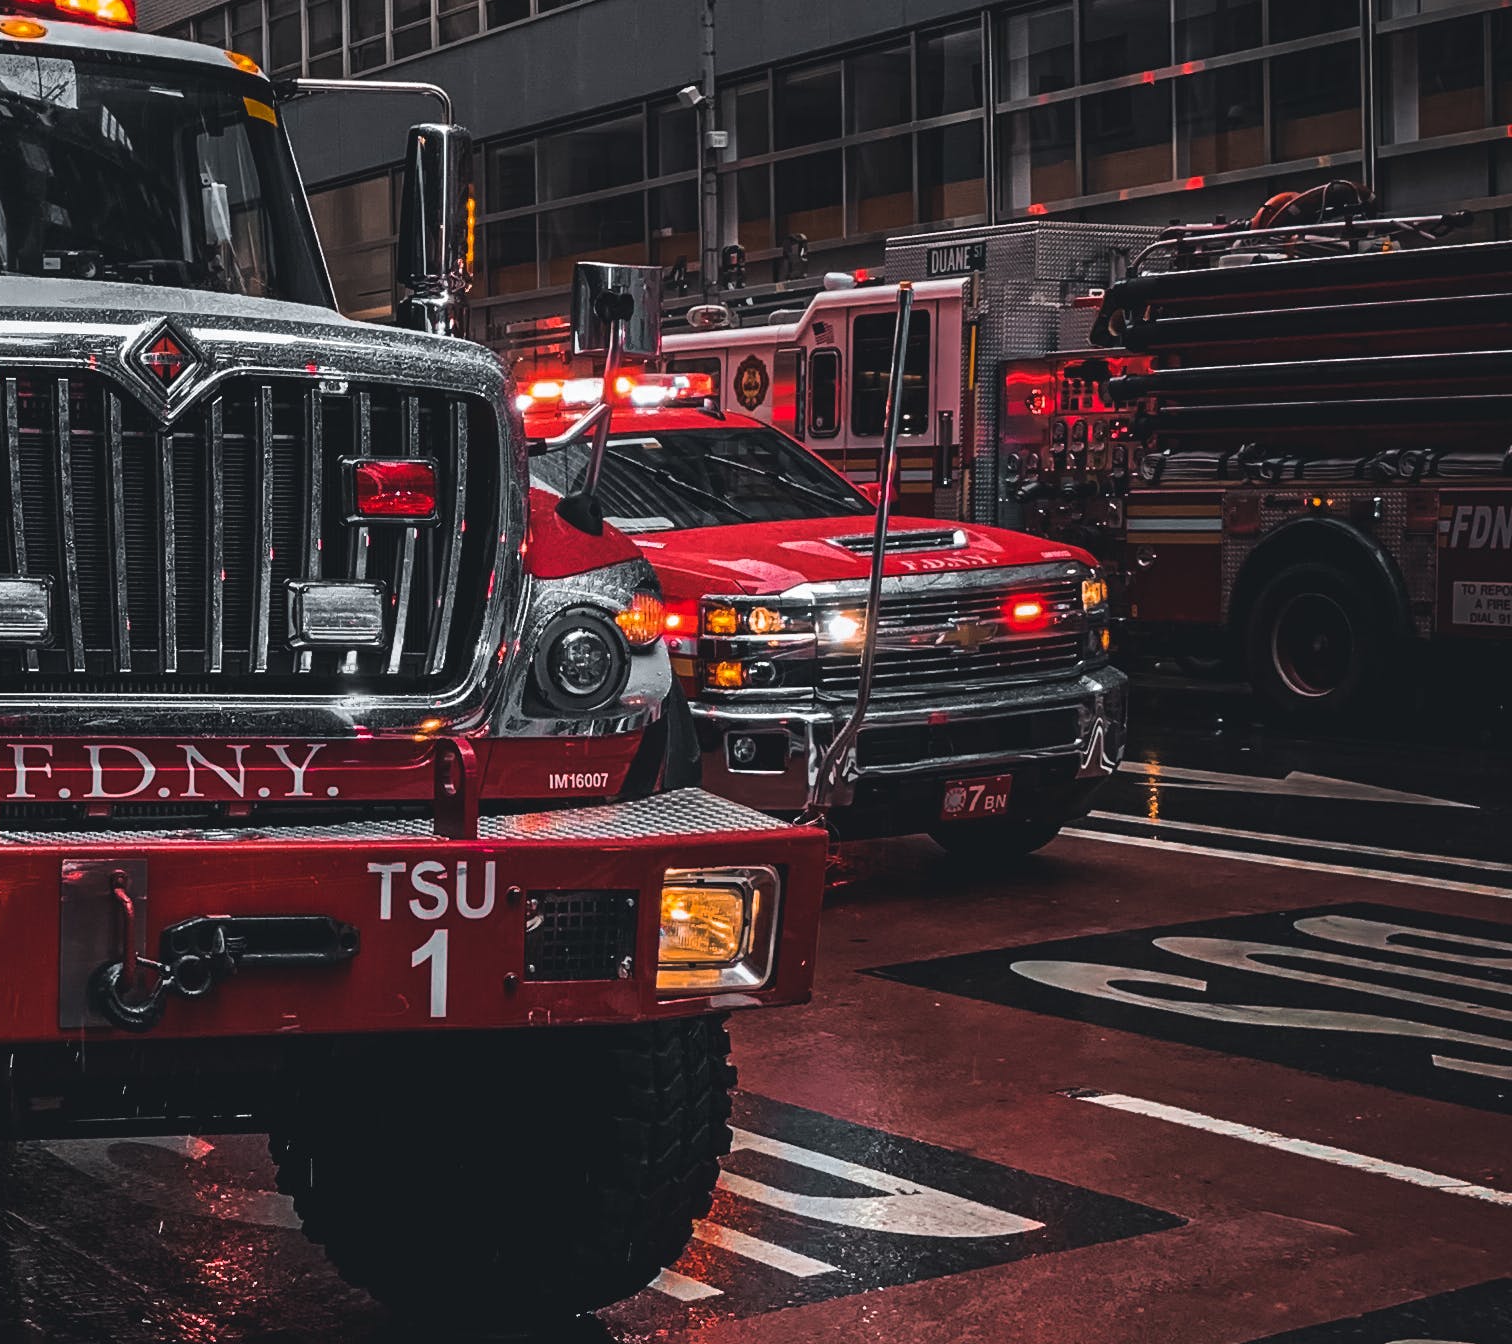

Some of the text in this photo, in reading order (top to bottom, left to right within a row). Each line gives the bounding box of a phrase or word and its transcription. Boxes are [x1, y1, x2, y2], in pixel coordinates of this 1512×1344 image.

[931, 244, 983, 274] DUANE ST
[1461, 583, 1477, 596] TO
[1470, 612, 1494, 624] DIAL
[1475, 598, 1511, 611] A FIRE
[6, 743, 339, 798] F.D.N.Y.
[549, 772, 609, 789] IM16007
[968, 784, 1007, 812] 7 BN
[367, 860, 496, 920] TSU
[411, 928, 449, 1018] 1
